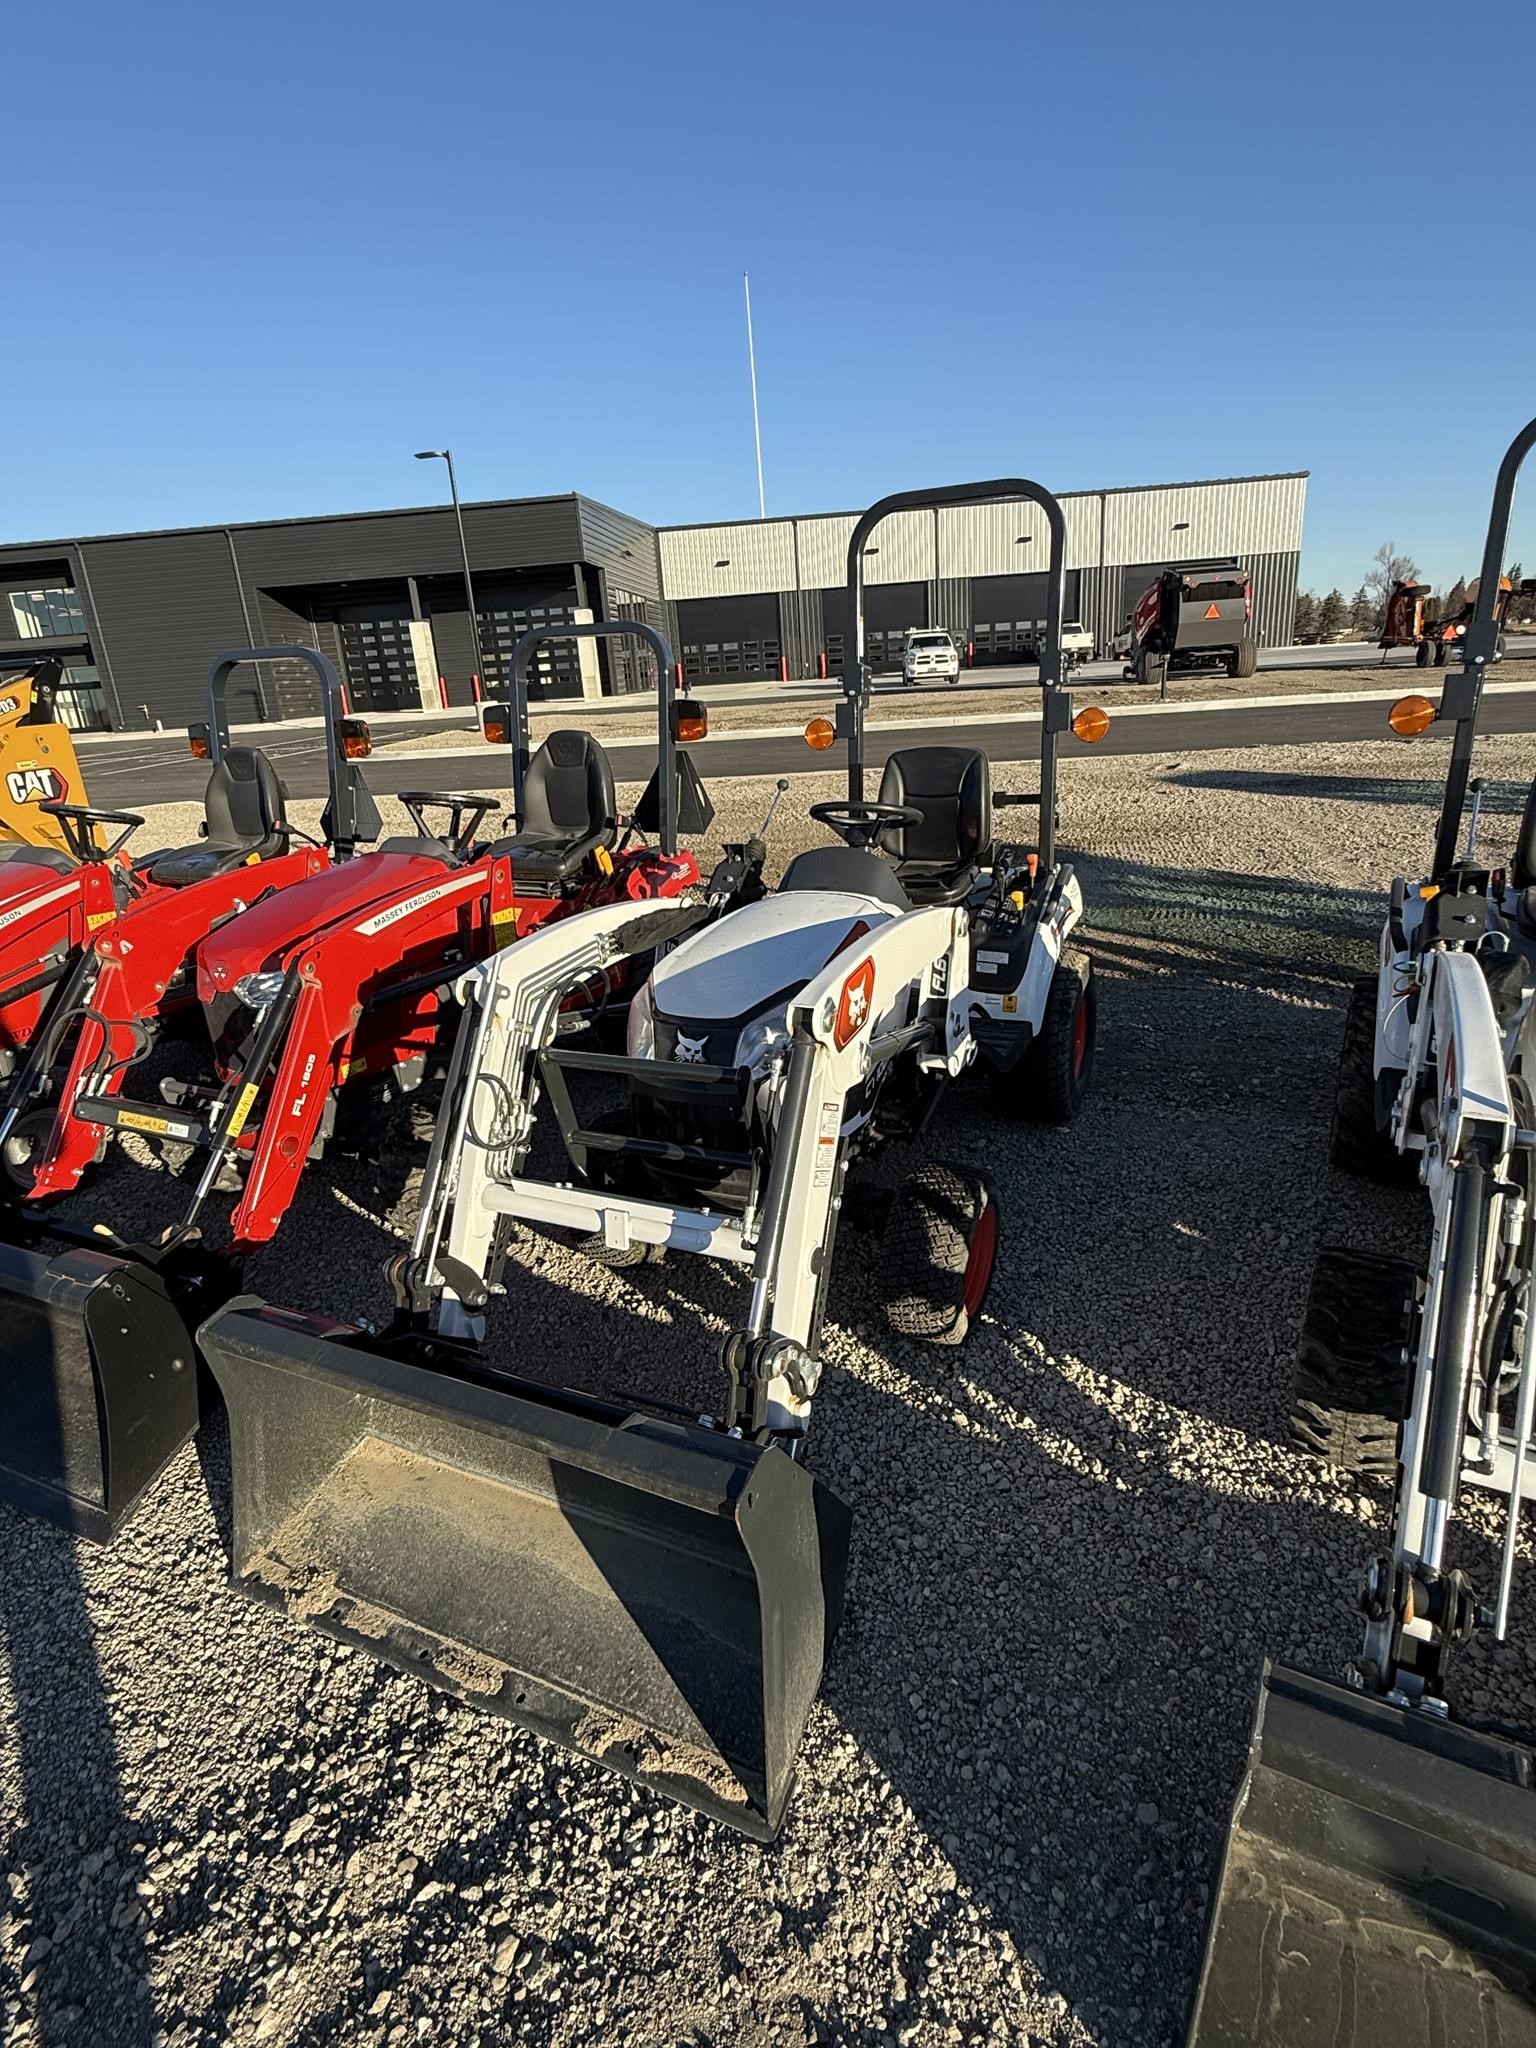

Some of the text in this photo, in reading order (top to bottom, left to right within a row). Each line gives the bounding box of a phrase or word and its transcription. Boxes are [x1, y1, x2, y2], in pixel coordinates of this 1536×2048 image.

[7, 769, 54, 803] CAT
[374, 890, 441, 928] MASSEY FERGUSON
[932, 958, 947, 993] FL6
[291, 1093, 307, 1117] FL
